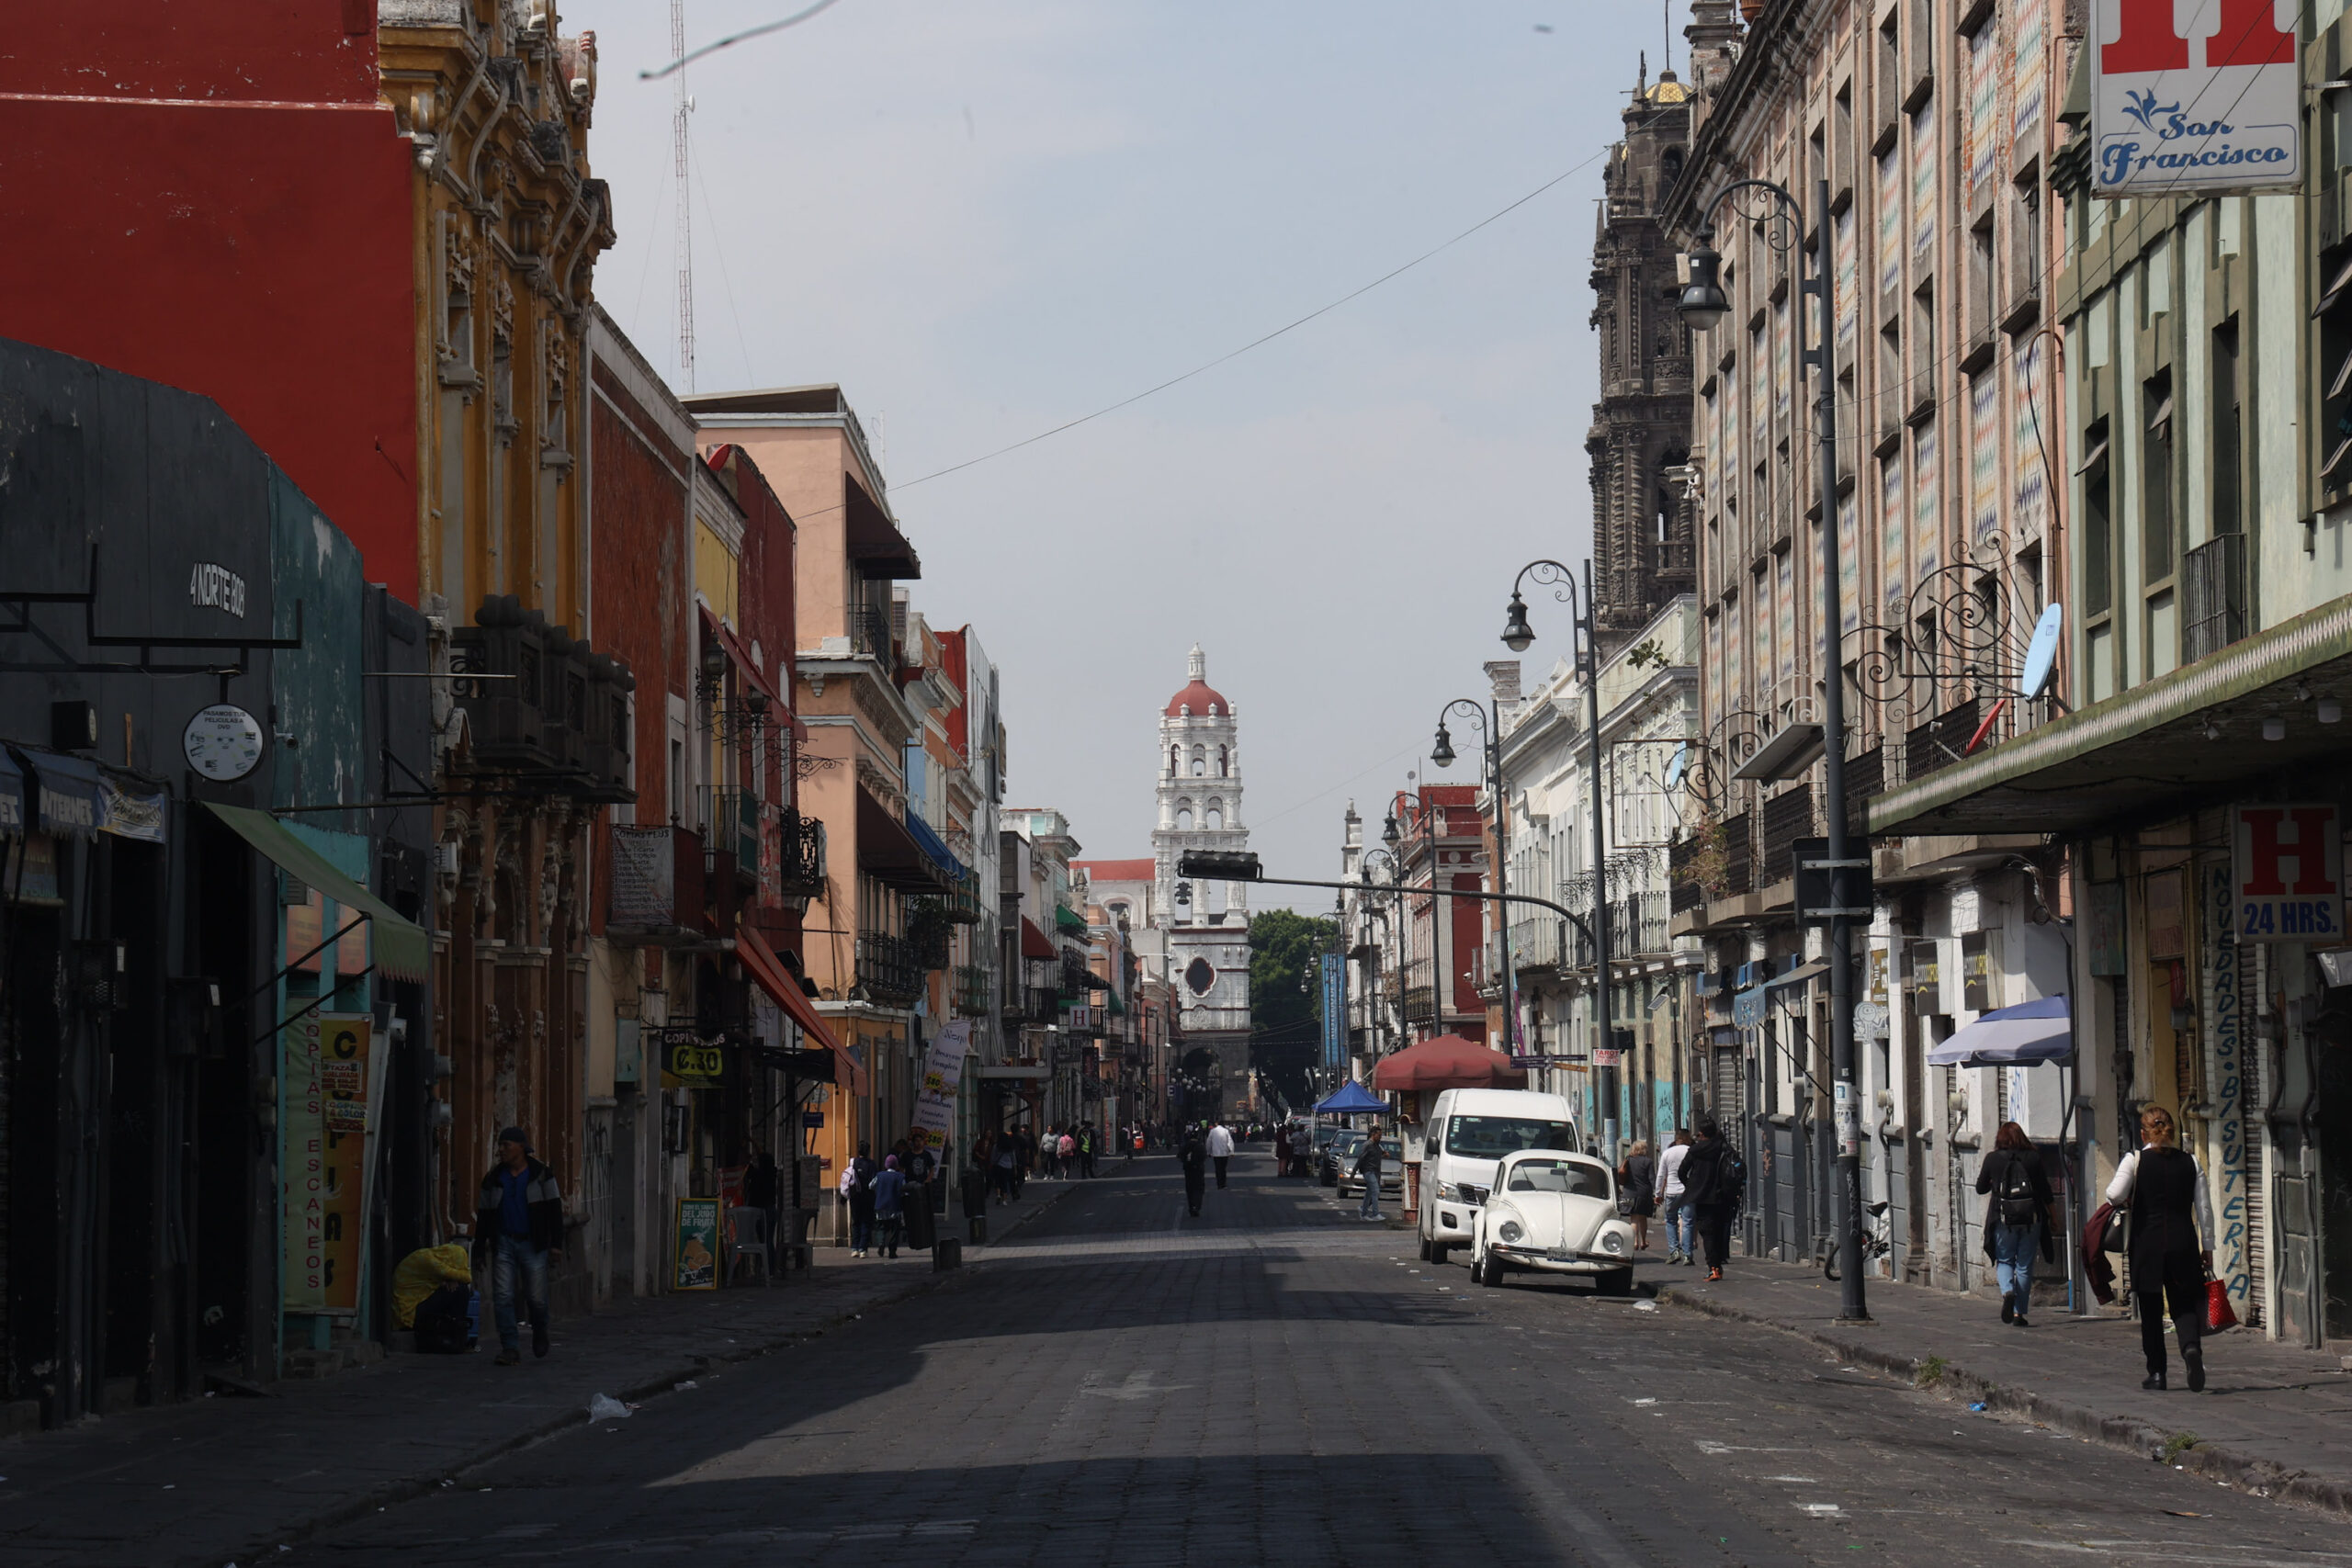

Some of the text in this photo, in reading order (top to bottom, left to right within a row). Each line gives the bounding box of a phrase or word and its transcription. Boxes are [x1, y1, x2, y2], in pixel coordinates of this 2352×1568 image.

[2159, 113, 2233, 140] San
[2100, 142, 2288, 185] Francisco
[189, 563, 245, 619] 4 NORTE 808
[40, 785, 94, 826] INTERNET
[613, 829, 670, 839] COPIAS PLUS
[2241, 807, 2336, 896] H
[2244, 901, 2338, 935] 24 HRS.
[1072, 1010, 1086, 1027] H
[664, 1032, 698, 1045] COPIS
[306, 1007, 321, 1289] COPIAS ESCANEOS
[2219, 1077, 2250, 1302] BISUTERIA
[681, 1218, 692, 1226] DE
